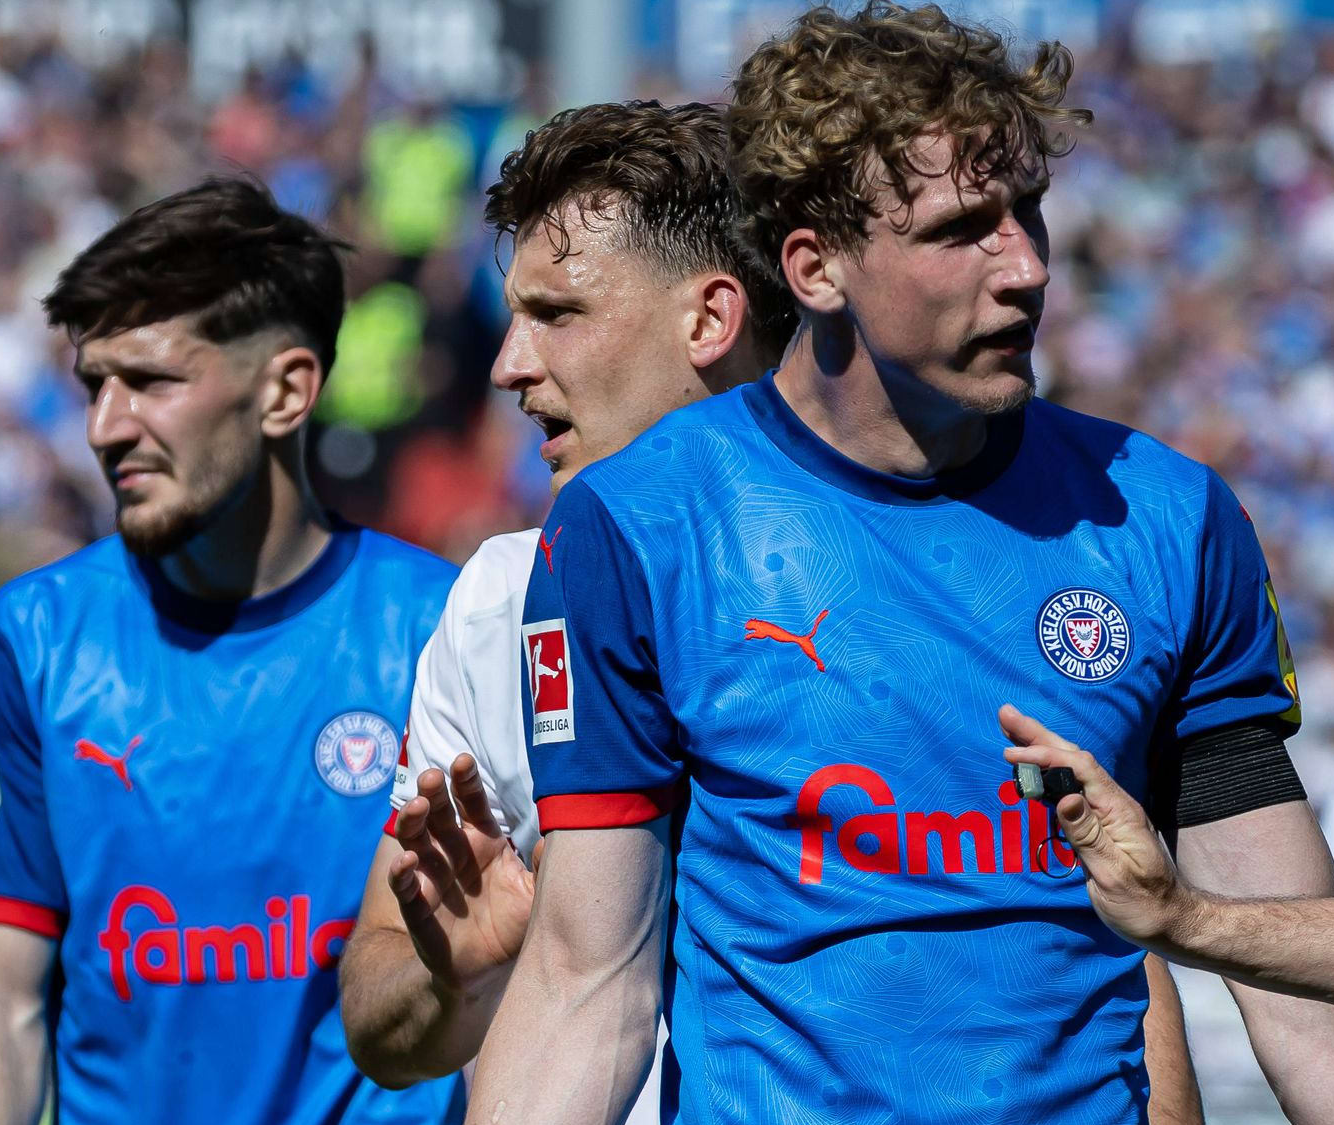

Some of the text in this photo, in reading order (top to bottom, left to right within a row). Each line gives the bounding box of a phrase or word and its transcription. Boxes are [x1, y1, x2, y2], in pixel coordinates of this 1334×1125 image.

[1042, 601, 1067, 652] KIELER
[1083, 594, 1127, 650] HOLSTEIN
[1058, 651, 1120, 678] VON 1900
